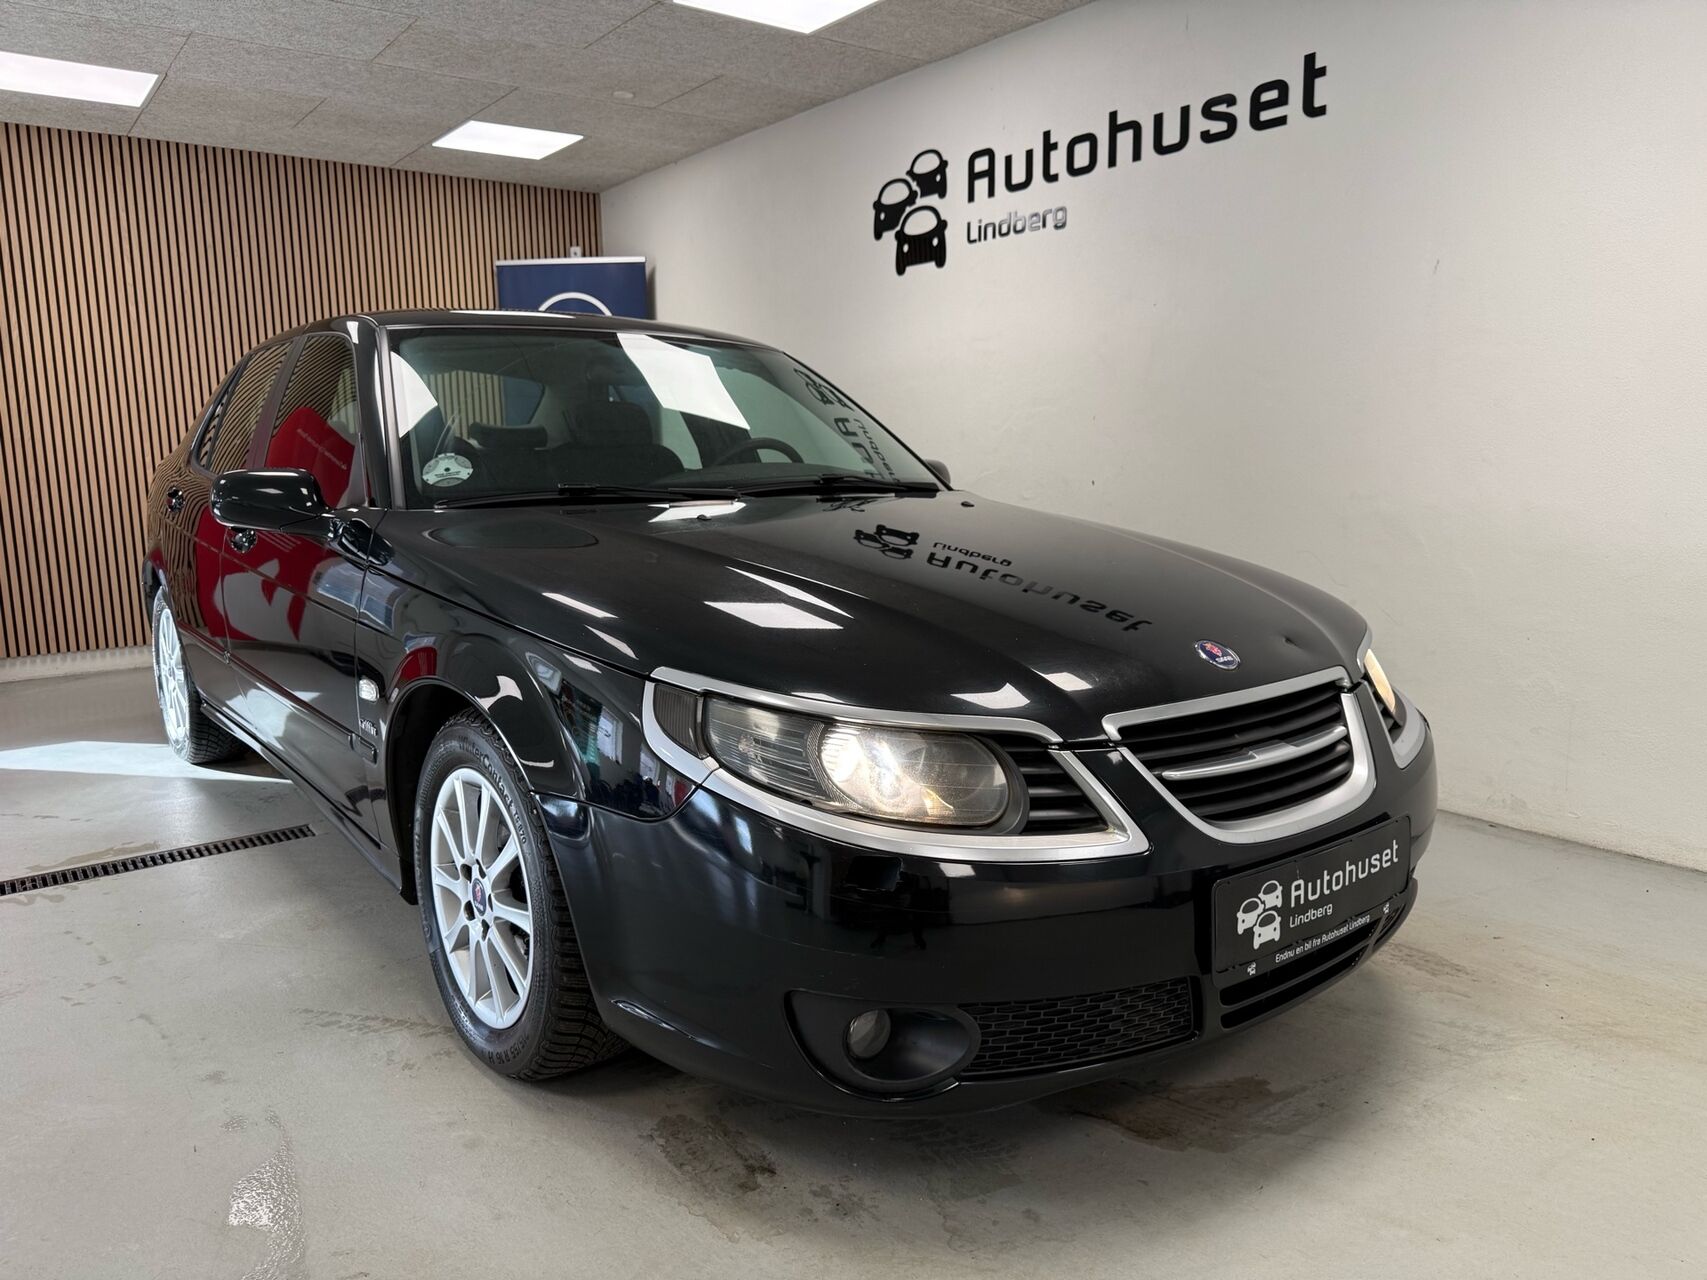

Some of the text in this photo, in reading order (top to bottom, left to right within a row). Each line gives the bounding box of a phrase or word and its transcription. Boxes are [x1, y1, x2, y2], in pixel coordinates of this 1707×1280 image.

[967, 52, 1327, 203] Autohuset
[967, 205, 1067, 244] Lindberg
[1291, 839, 1399, 908] Autohuset
[1275, 914, 1370, 963] Endnu en bil fra Autohuset Lindberg
[1290, 903, 1333, 928] Lindberg
